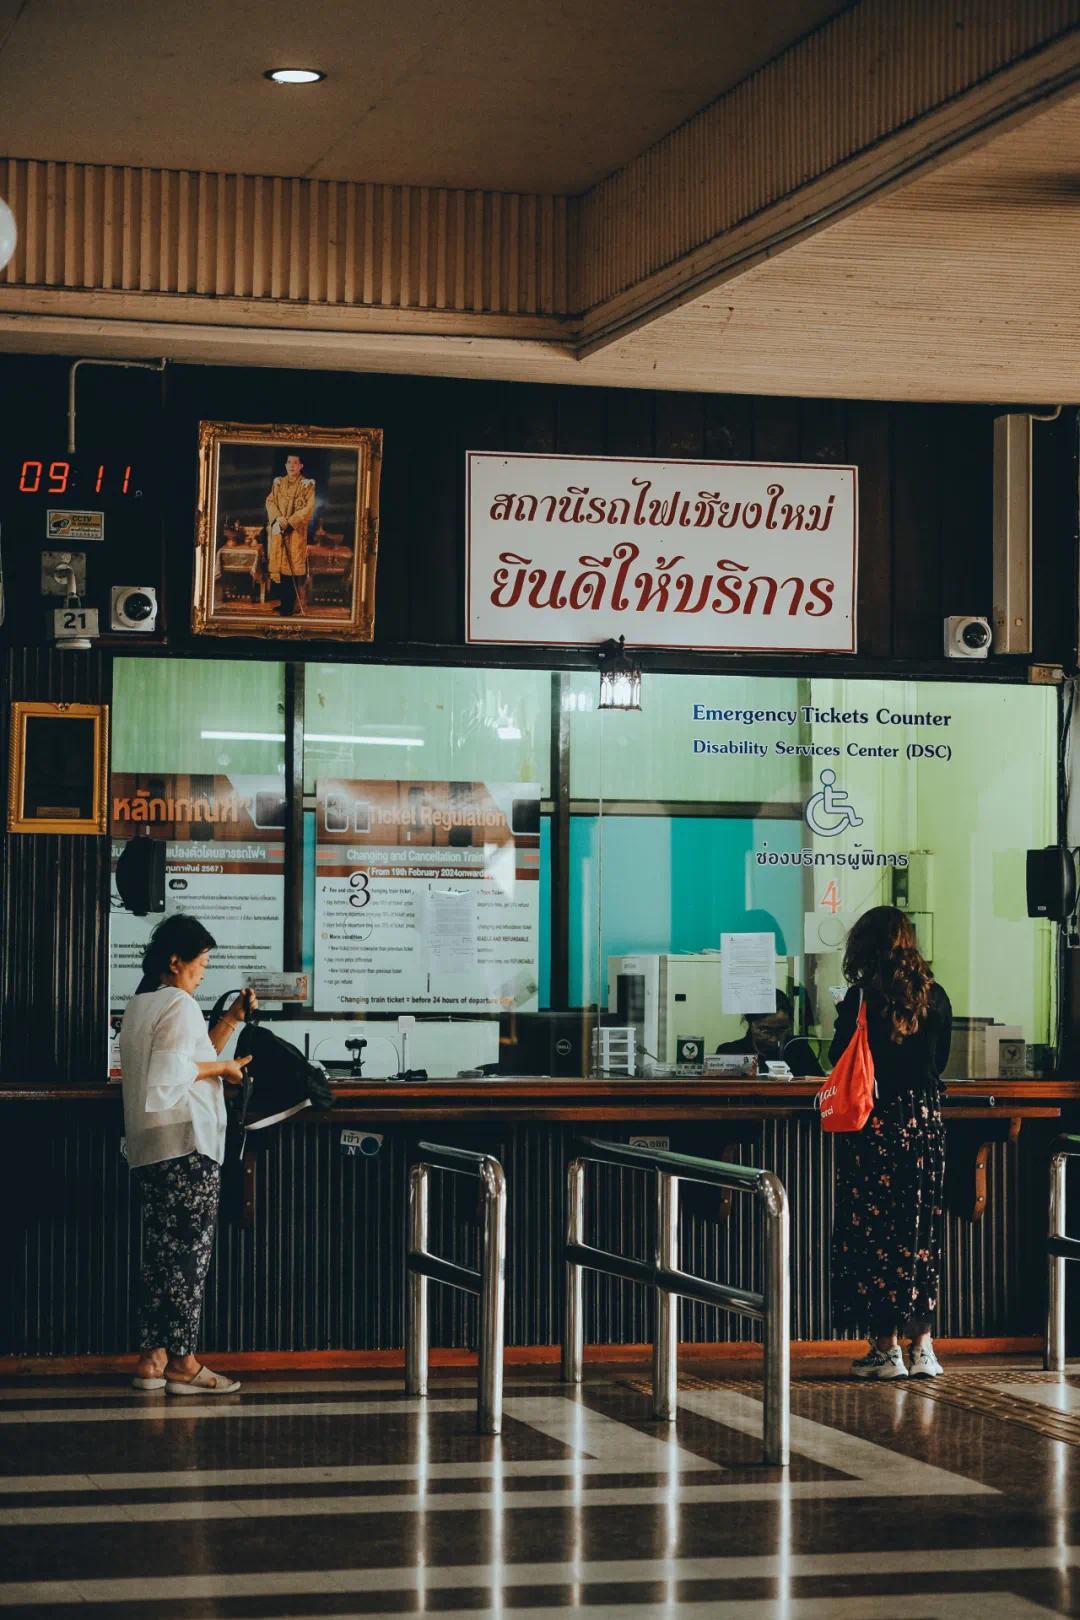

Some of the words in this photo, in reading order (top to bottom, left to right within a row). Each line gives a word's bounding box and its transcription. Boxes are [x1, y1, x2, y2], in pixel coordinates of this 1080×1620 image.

[489, 477, 835, 532] สถานีรถไฟเชียงใหม่
[490, 541, 835, 617] ยินดีให้บริการ
[63, 613, 86, 629] 21
[693, 704, 797, 726] Emergency
[802, 706, 869, 723] Tickets
[876, 708, 952, 726] Counter
[693, 739, 768, 758] Disability
[775, 741, 840, 756] Services
[846, 743, 899, 757] Center
[906, 744, 952, 761] (DSC)
[421, 805, 506, 832] Regulation
[346, 848, 388, 864] Changing
[390, 850, 407, 862] and
[409, 850, 461, 863] Cancellation
[756, 842, 908, 870] ช่องบริการผู้พิการ
[372, 867, 390, 876] From
[409, 868, 439, 879] February
[348, 872, 371, 907] 3
[821, 880, 841, 913] 4
[411, 996, 431, 1004] before
[442, 996, 459, 1004] hours
[460, 996, 467, 1004] of
